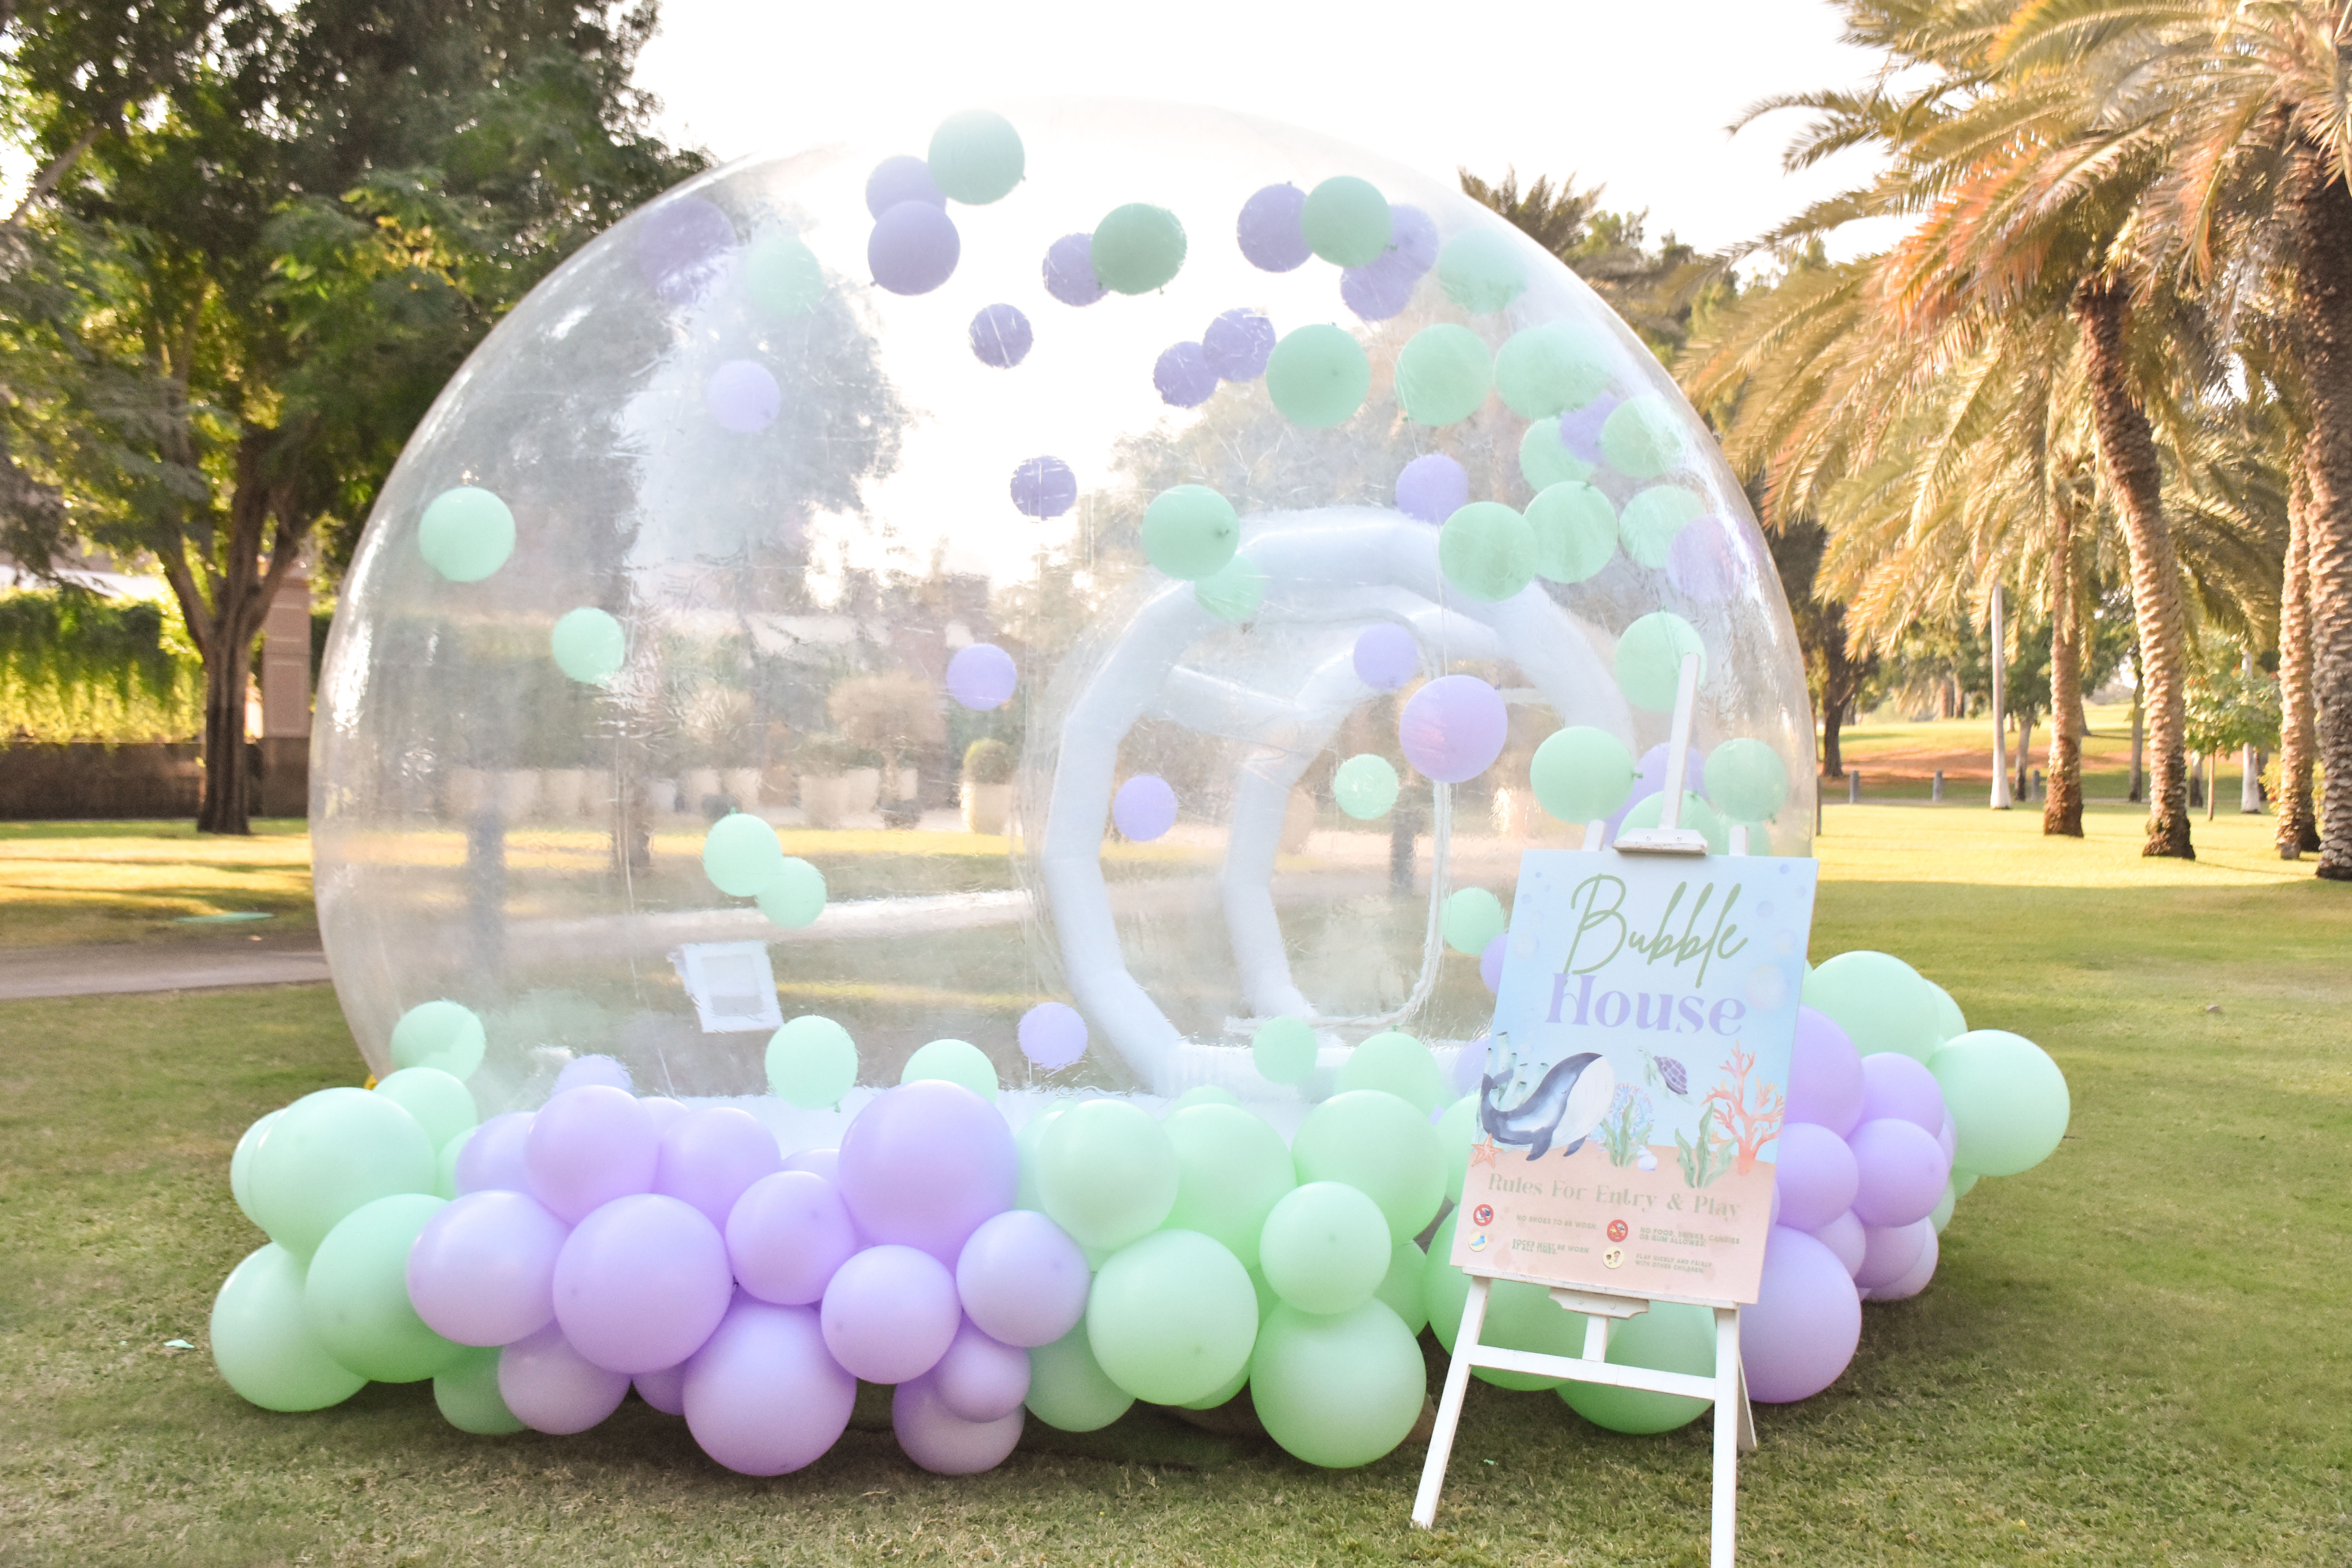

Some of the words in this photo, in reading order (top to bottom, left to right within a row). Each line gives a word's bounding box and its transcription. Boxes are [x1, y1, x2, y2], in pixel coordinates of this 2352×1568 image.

[1563, 873, 1748, 989] Bubble
[1545, 973, 1746, 1035] House
[1488, 1173, 1542, 1195] Rules
[1552, 1180, 1587, 1200] For
[1595, 1185, 1657, 1212] Entry
[1667, 1193, 1684, 1210] &
[1694, 1196, 1740, 1222] Play
[1529, 1216, 1551, 1224] SHOES
[1708, 1235, 1740, 1244] CANDIES
